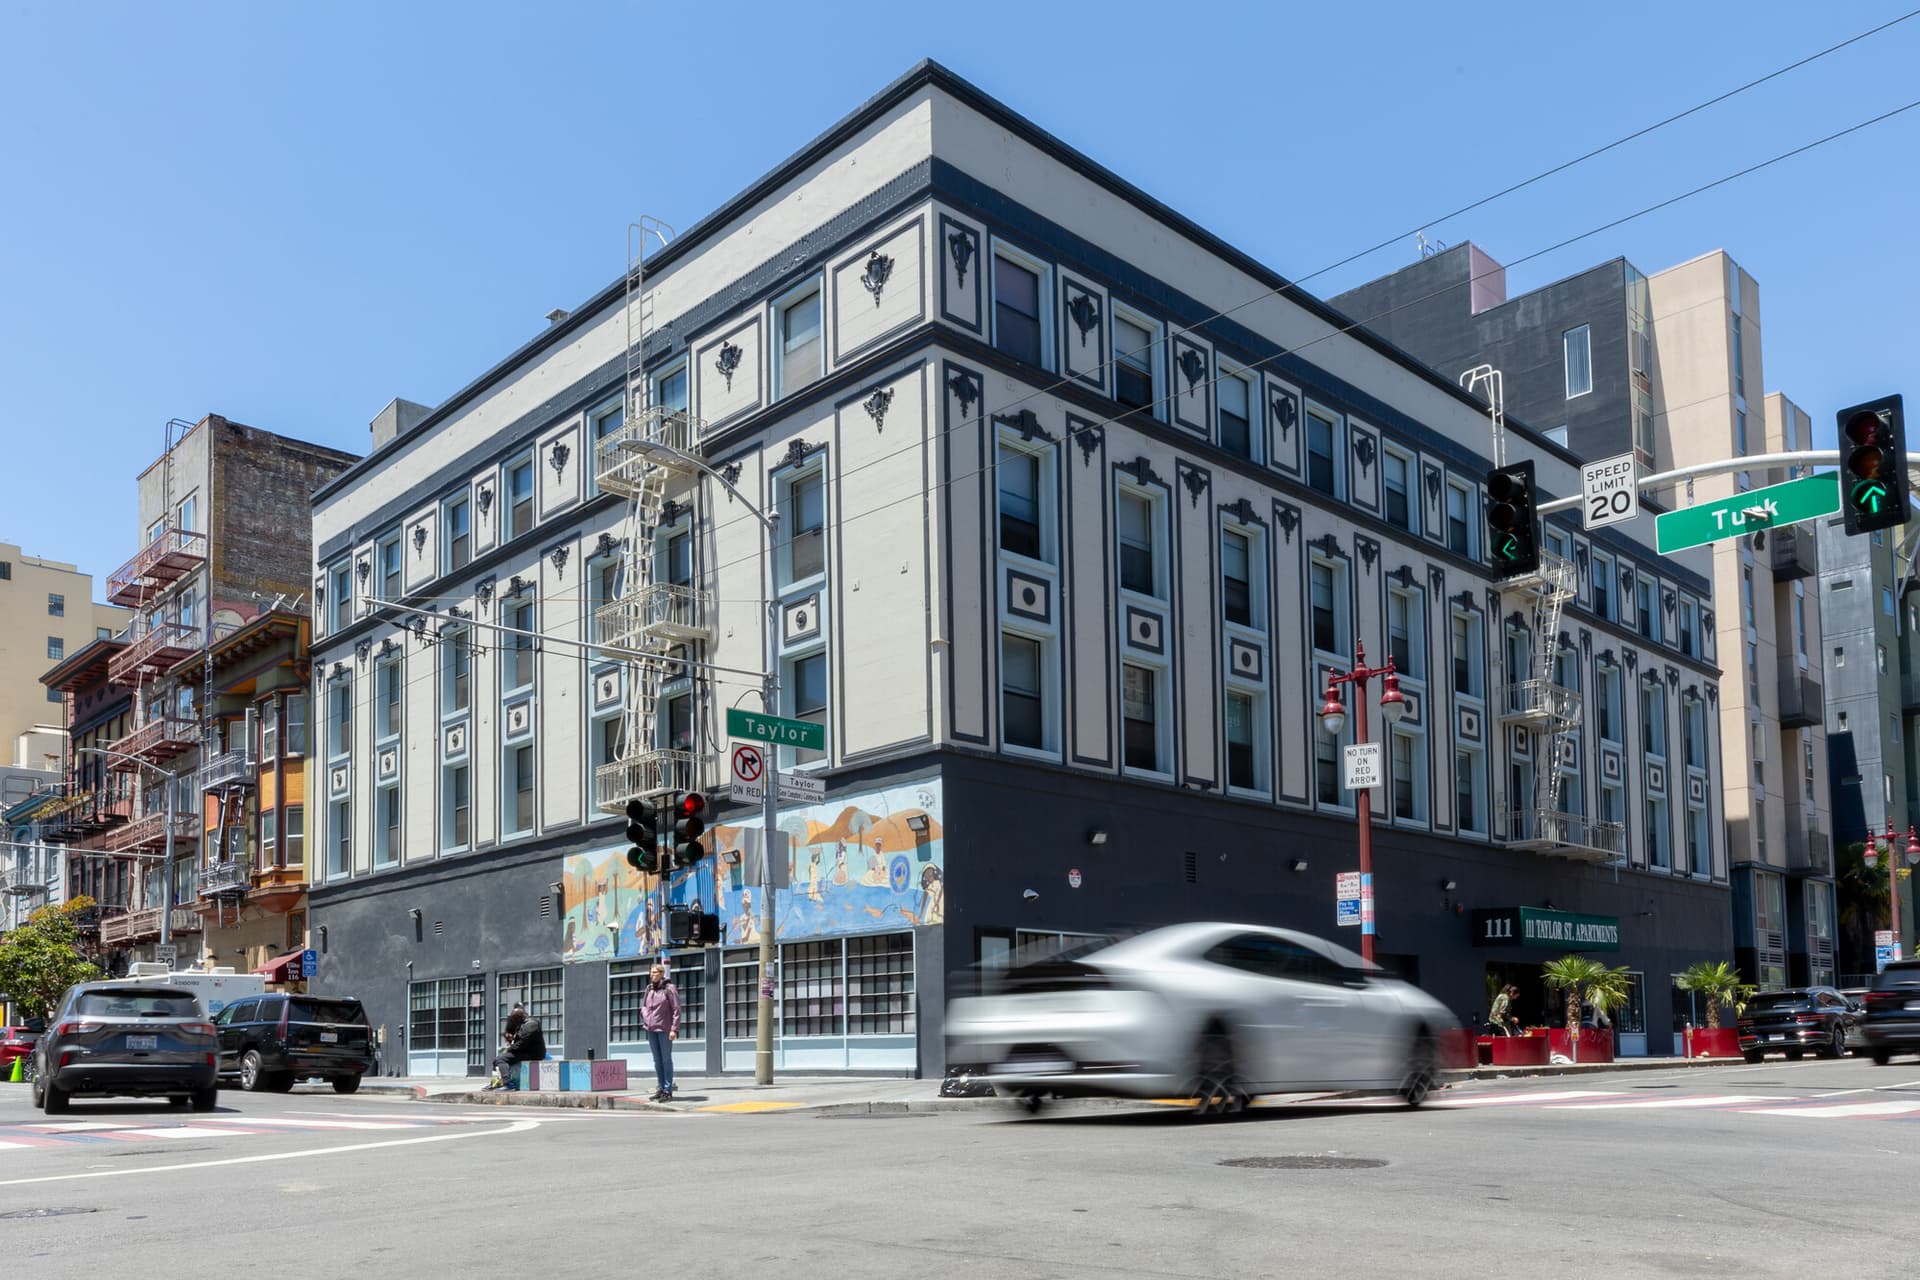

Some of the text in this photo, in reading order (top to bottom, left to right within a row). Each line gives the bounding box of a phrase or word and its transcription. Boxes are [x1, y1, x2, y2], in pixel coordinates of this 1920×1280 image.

[1587, 462, 1630, 481] SPEED
[1592, 476, 1626, 493] LIMIT
[1590, 490, 1630, 520] 20
[1711, 498, 1779, 530] Tuk
[745, 718, 807, 741] Taylor
[1347, 747, 1377, 757] NO TURN
[1357, 757, 1368, 765] ON
[1355, 767, 1370, 775] RED
[790, 777, 815, 789] Taylor
[1350, 776, 1376, 784] ARROW
[733, 784, 761, 798] ON RED
[1484, 918, 1512, 938] 111
[1525, 919, 1618, 943] 111 TAYLOR ST. APARTMENTS
